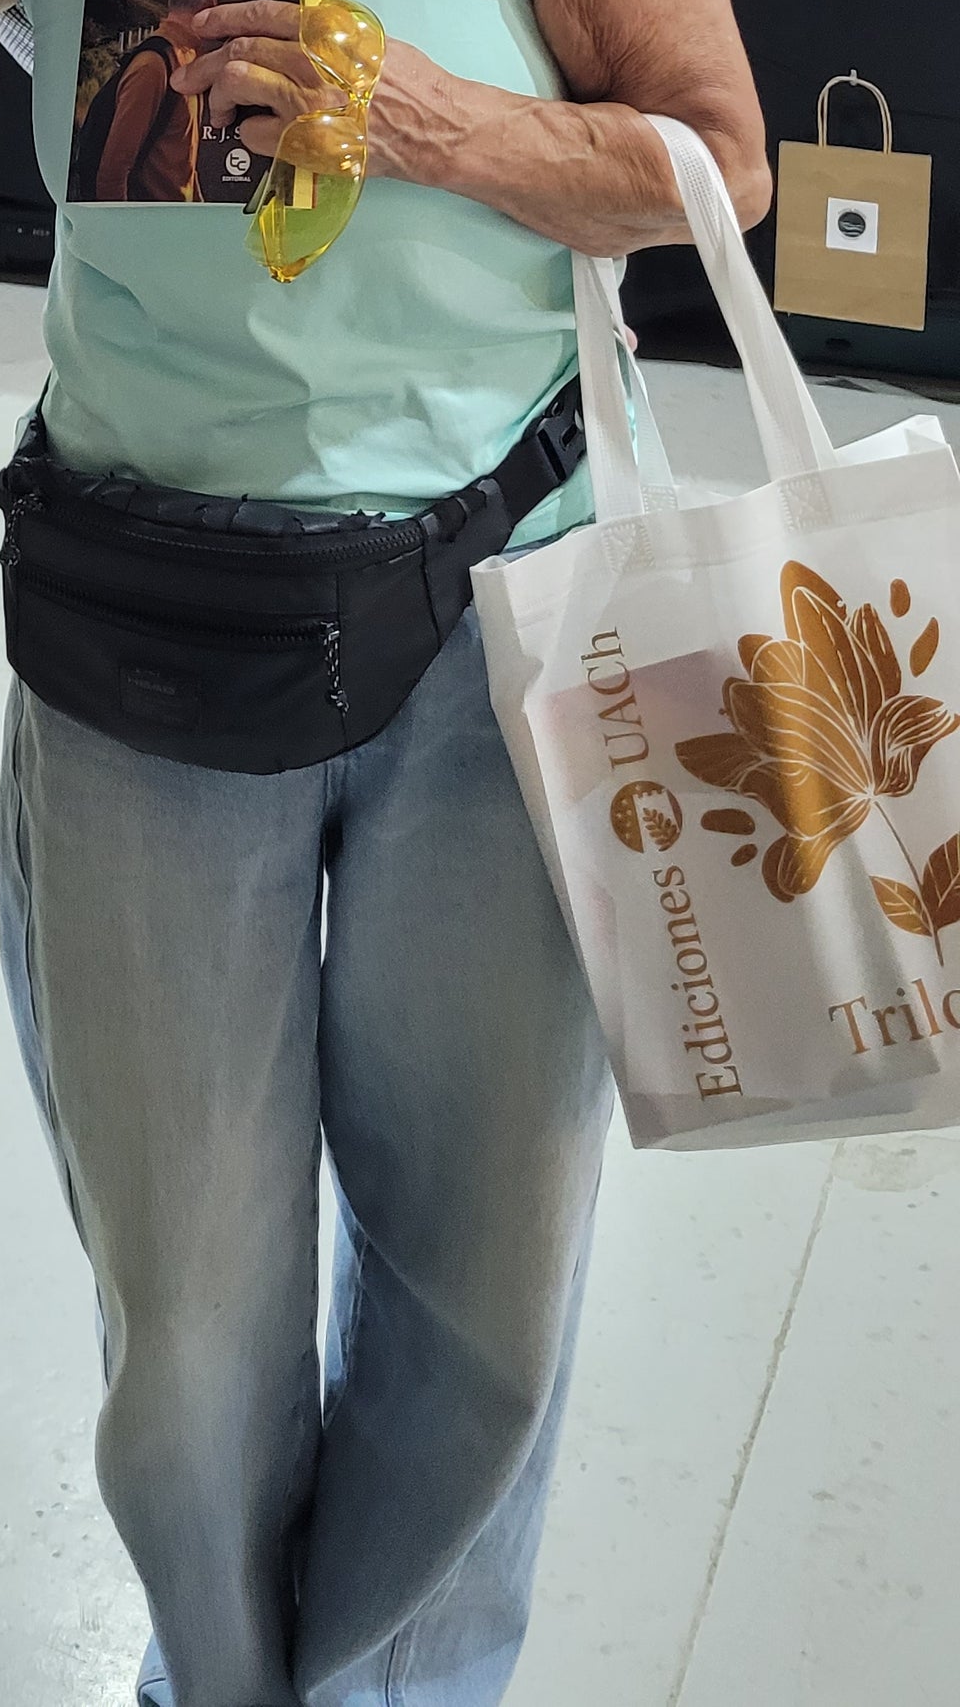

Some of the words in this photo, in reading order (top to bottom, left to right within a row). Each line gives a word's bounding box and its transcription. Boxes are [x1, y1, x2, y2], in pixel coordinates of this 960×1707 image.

[201, 126, 217, 140] R.
[219, 126, 230, 143] J.
[580, 626, 650, 770] UACh
[652, 864, 744, 1101] Ediciones
